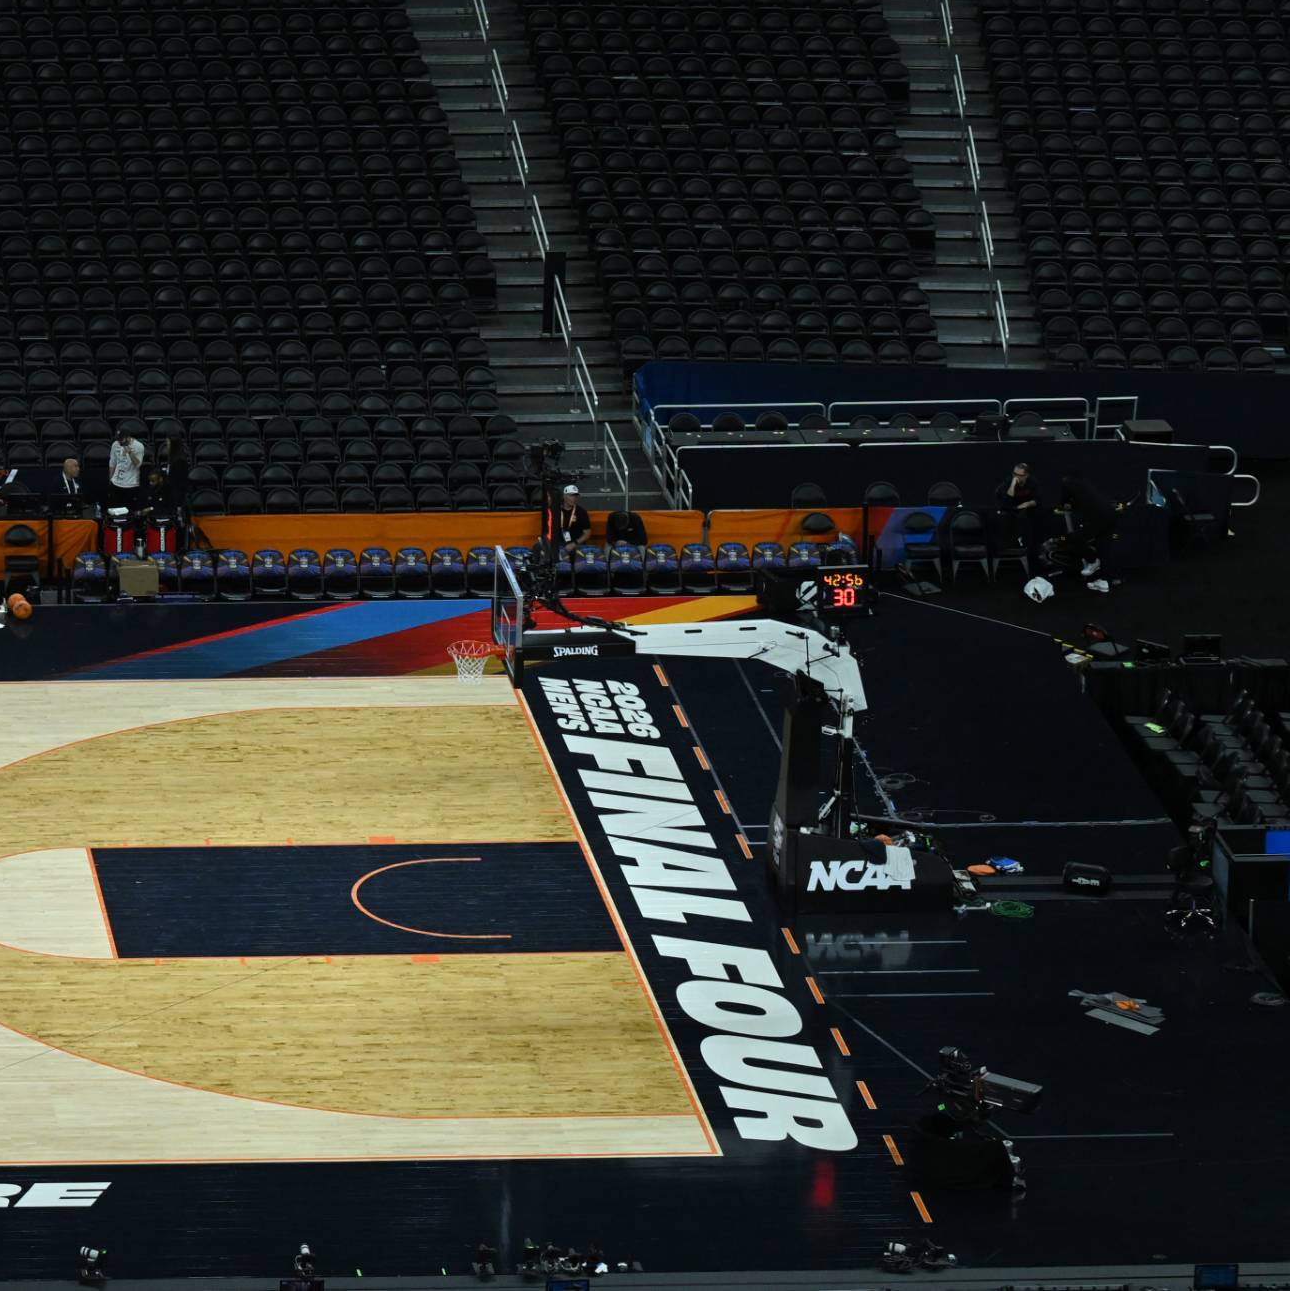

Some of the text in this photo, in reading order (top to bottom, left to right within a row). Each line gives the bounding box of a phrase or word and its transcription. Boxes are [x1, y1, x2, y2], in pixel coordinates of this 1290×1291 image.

[823, 573, 864, 587] 42:56
[833, 588, 855, 606] 30
[553, 645, 599, 658] SPALDING
[538, 676, 581, 732] MEN'S
[571, 677, 614, 734] NCAA
[606, 679, 661, 739] 2026
[563, 735, 859, 1151] FINAL FOUR
